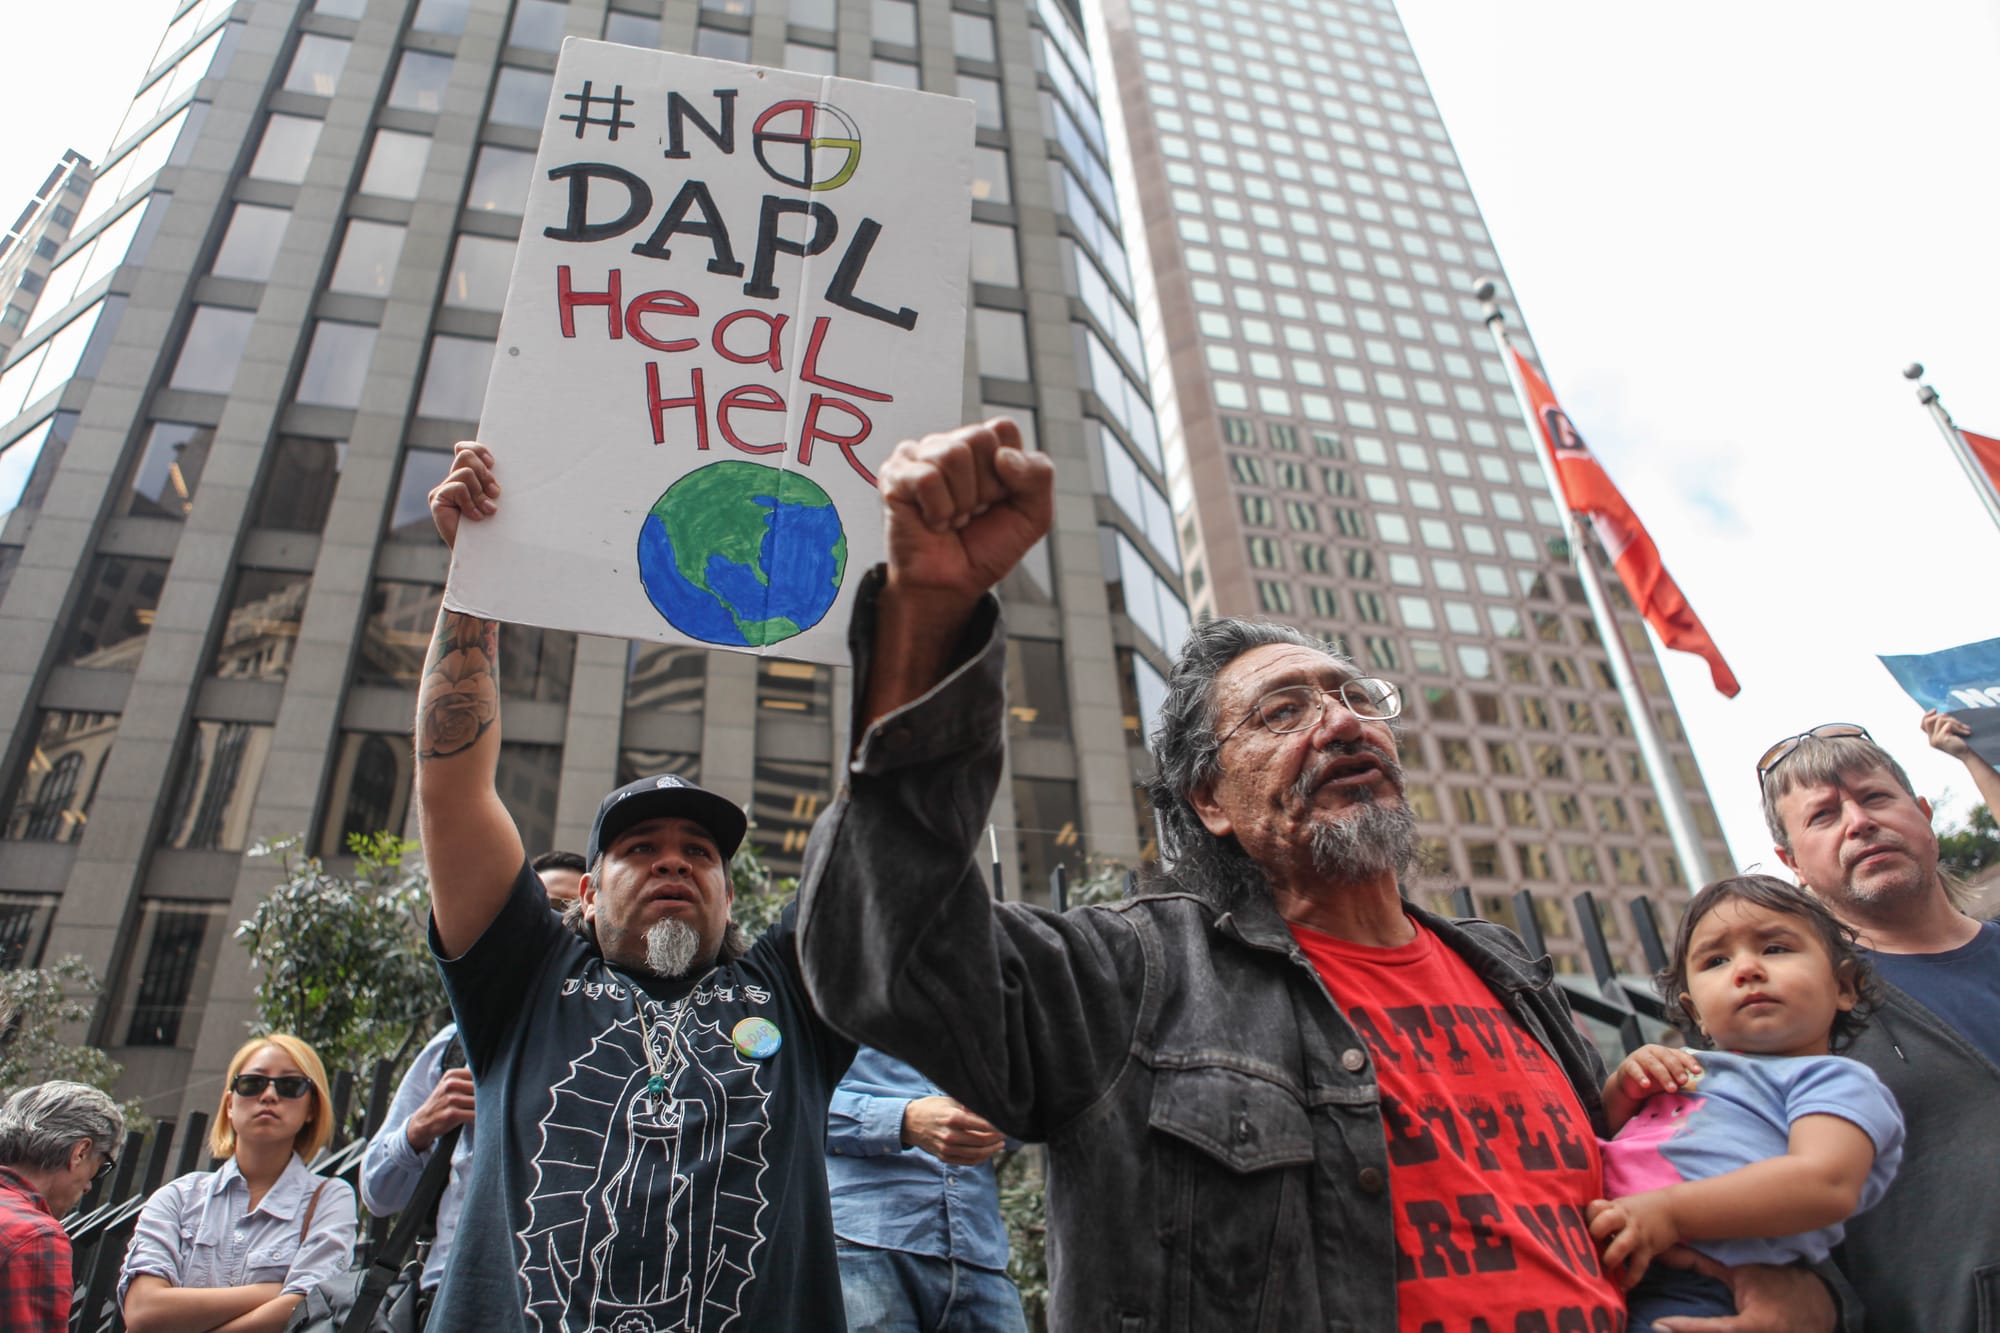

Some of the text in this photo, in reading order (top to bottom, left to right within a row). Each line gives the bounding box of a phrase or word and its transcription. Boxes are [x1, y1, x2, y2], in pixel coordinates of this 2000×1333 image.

[543, 162, 919, 332] DAPL
[1348, 1003, 1549, 1075] ATIVE
[1380, 1088, 1590, 1171] EPLE
[1396, 1193, 1601, 1281] RE NO
